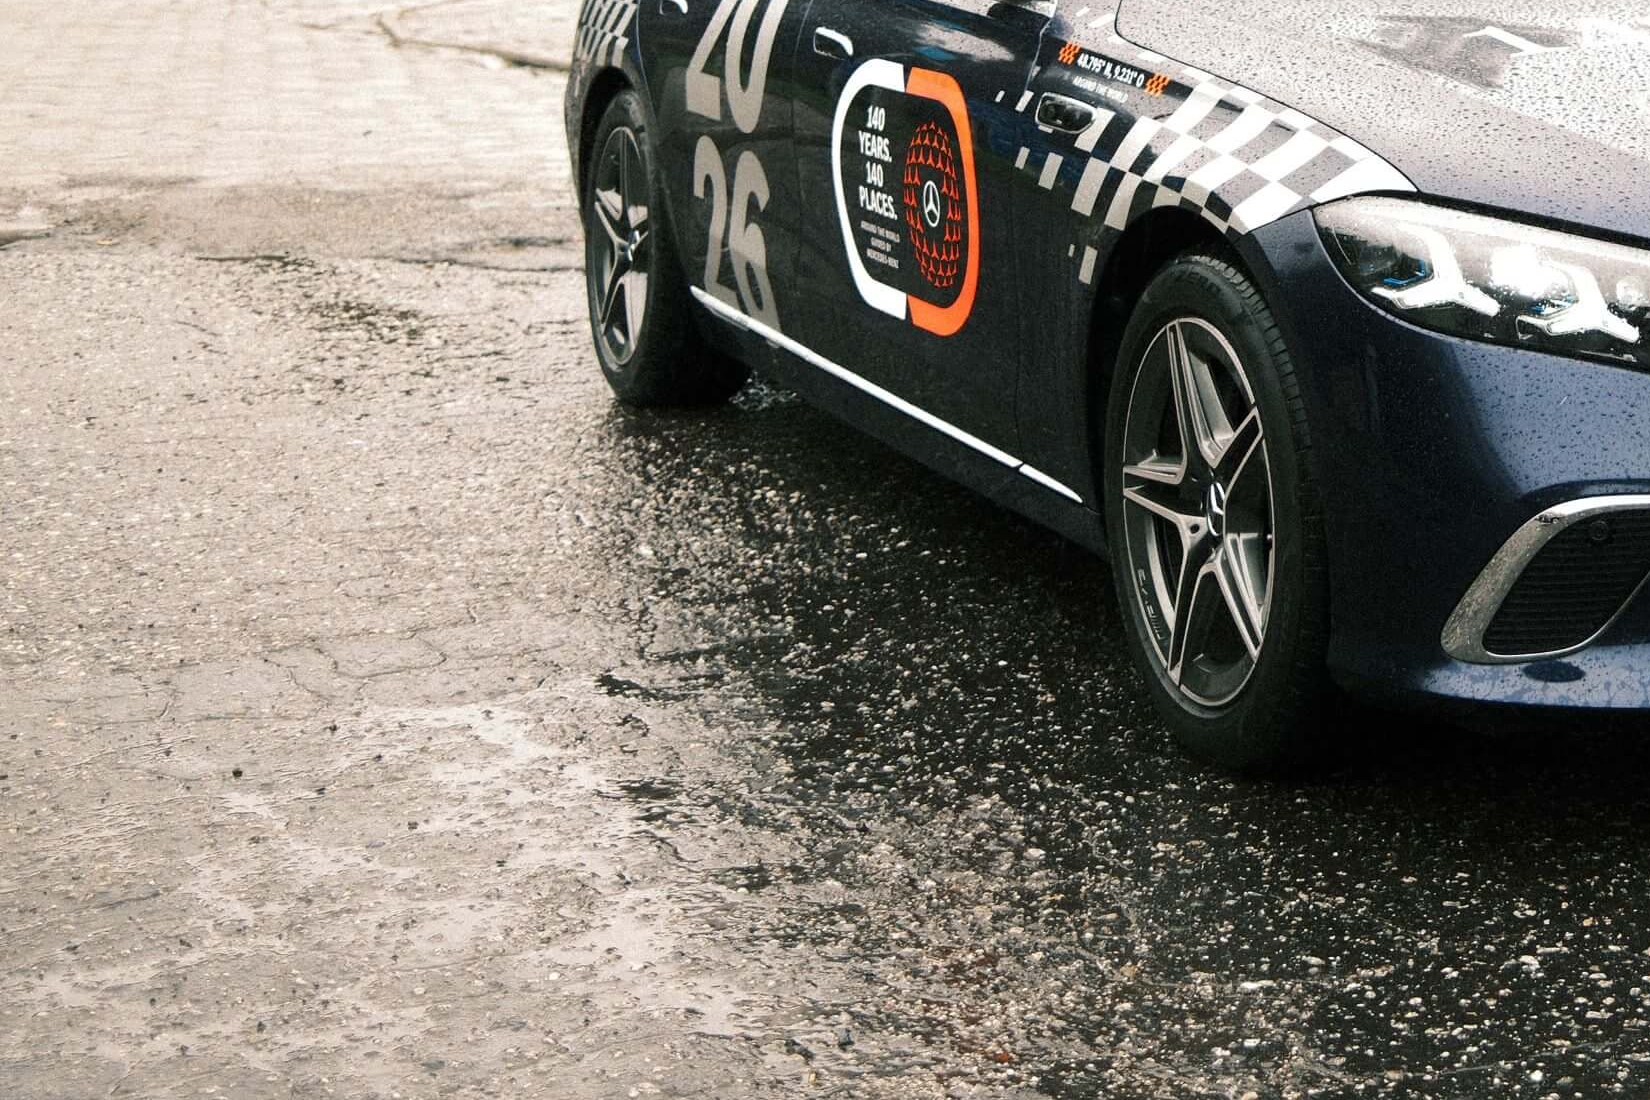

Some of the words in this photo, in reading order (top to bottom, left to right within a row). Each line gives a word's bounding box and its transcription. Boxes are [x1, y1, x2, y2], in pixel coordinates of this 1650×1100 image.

[866, 105, 886, 131] 140
[859, 130, 893, 162] YEARS.
[866, 161, 884, 188] 140
[859, 185, 898, 220] PLACES.
[693, 135, 783, 348] 26
